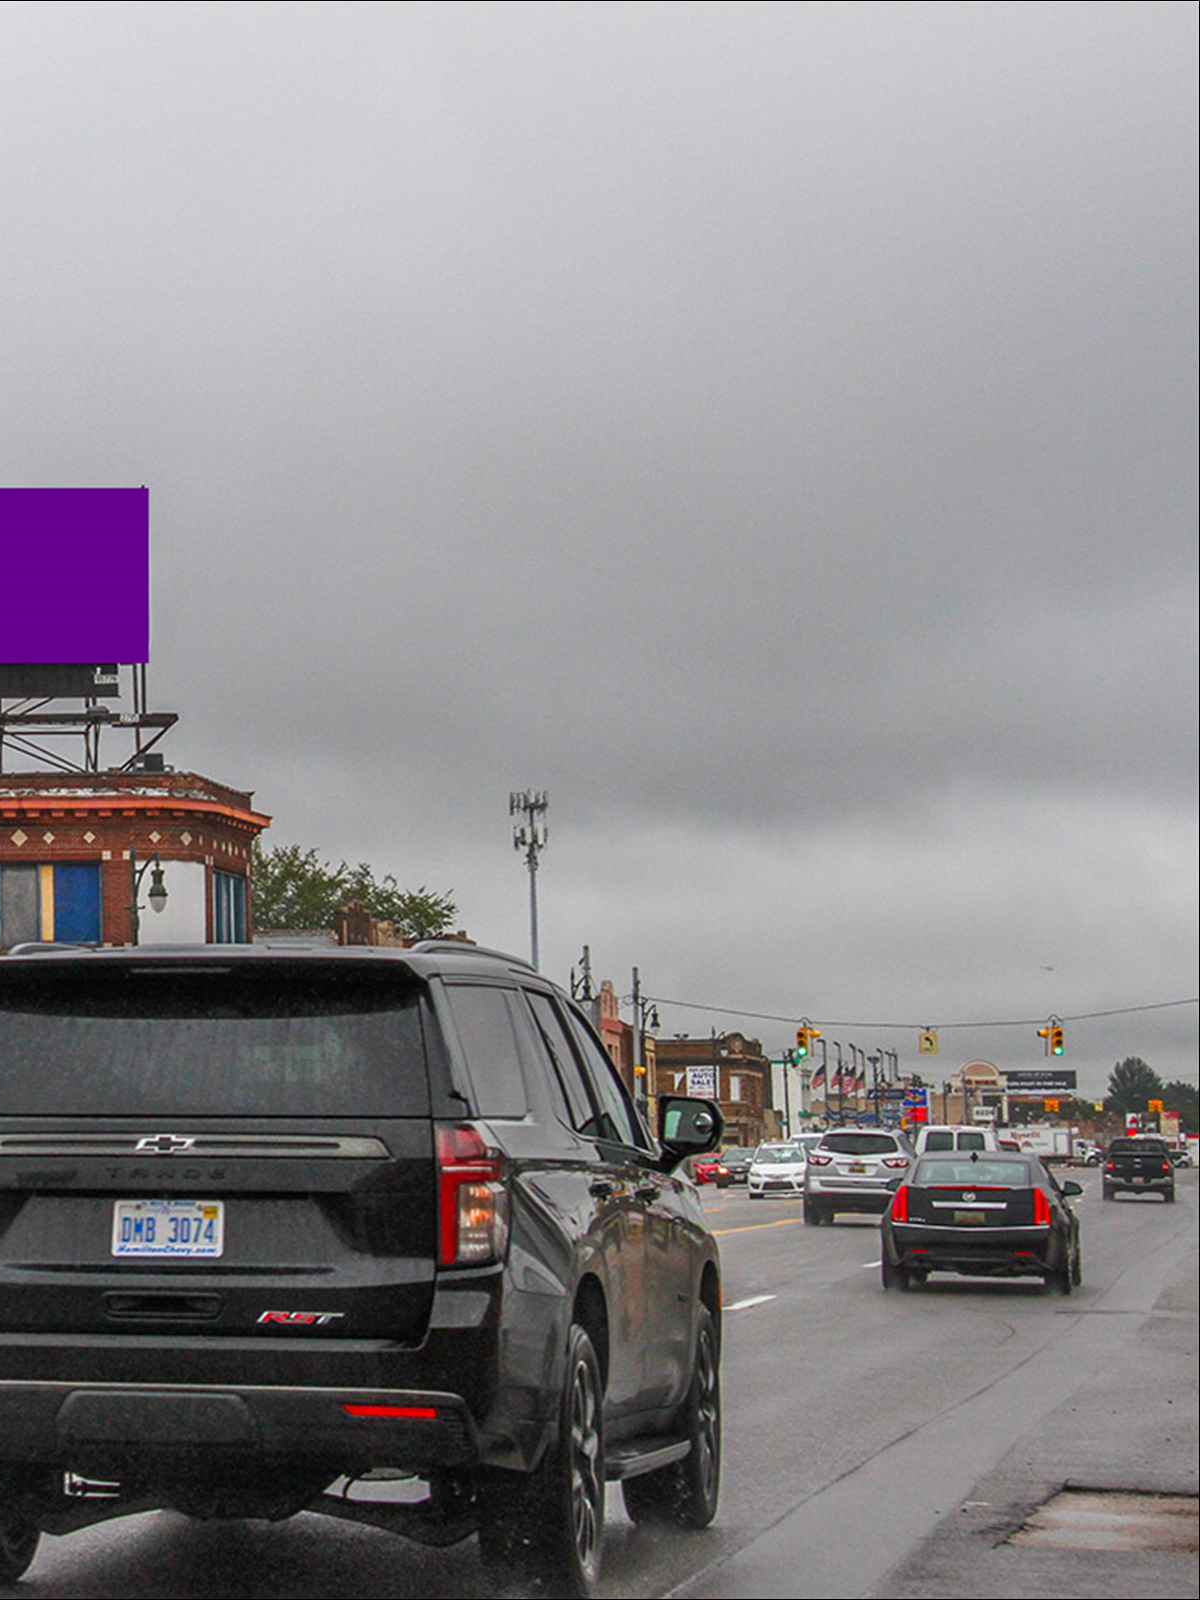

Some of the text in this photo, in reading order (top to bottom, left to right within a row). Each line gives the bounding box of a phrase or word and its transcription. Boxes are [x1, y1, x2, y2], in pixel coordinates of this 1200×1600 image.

[120, 1216, 215, 1243] DMB 3074
[256, 1310, 345, 1325] RST
